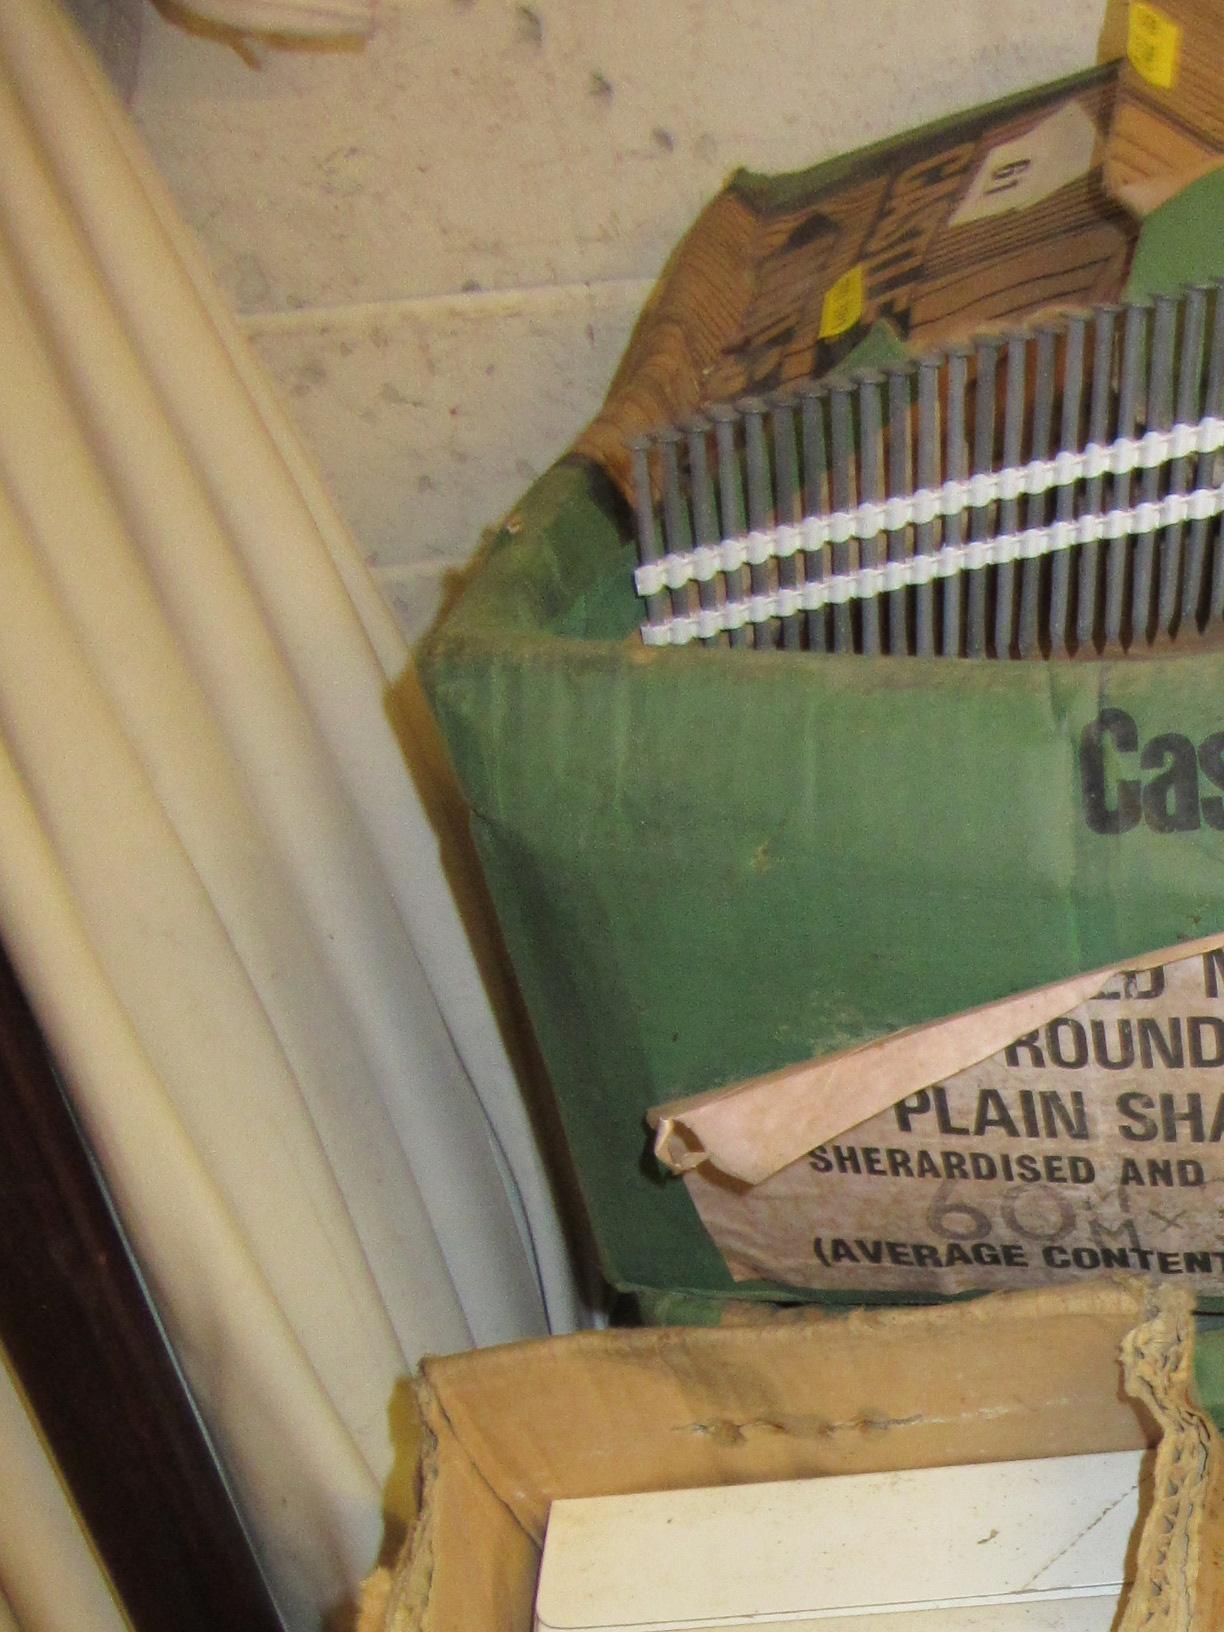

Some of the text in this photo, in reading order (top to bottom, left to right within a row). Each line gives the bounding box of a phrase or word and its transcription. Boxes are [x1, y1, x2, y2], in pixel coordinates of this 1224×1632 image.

[893, 1085, 1090, 1140] PLAIN
[808, 1144, 1096, 1184] SHERARDISED
[1120, 1156, 1205, 1188] AND
[813, 1236, 1029, 1268] (AVERAGE
